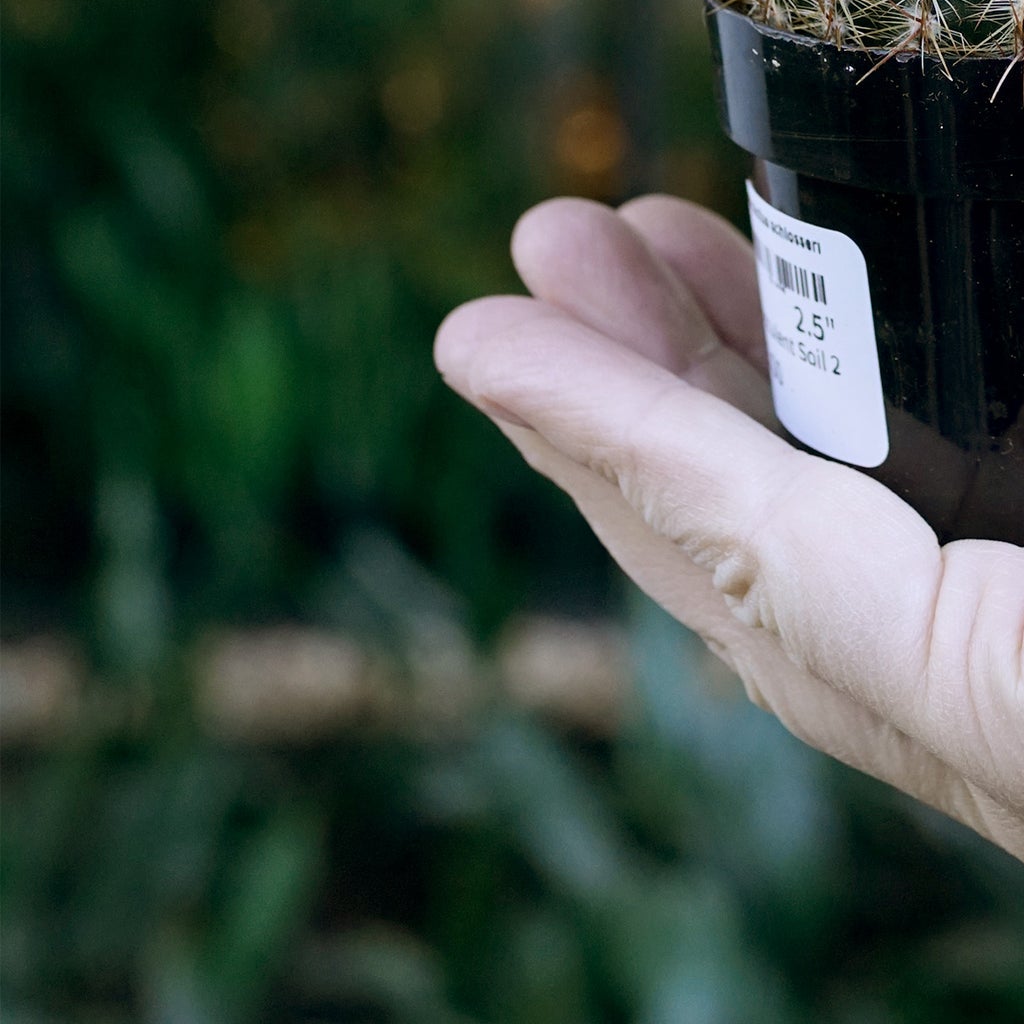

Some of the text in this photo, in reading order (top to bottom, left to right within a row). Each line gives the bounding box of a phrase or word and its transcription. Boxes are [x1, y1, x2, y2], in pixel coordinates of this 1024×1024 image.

[793, 305, 835, 341] 2.5"
[797, 341, 827, 372] Soil
[830, 354, 842, 376] 2
